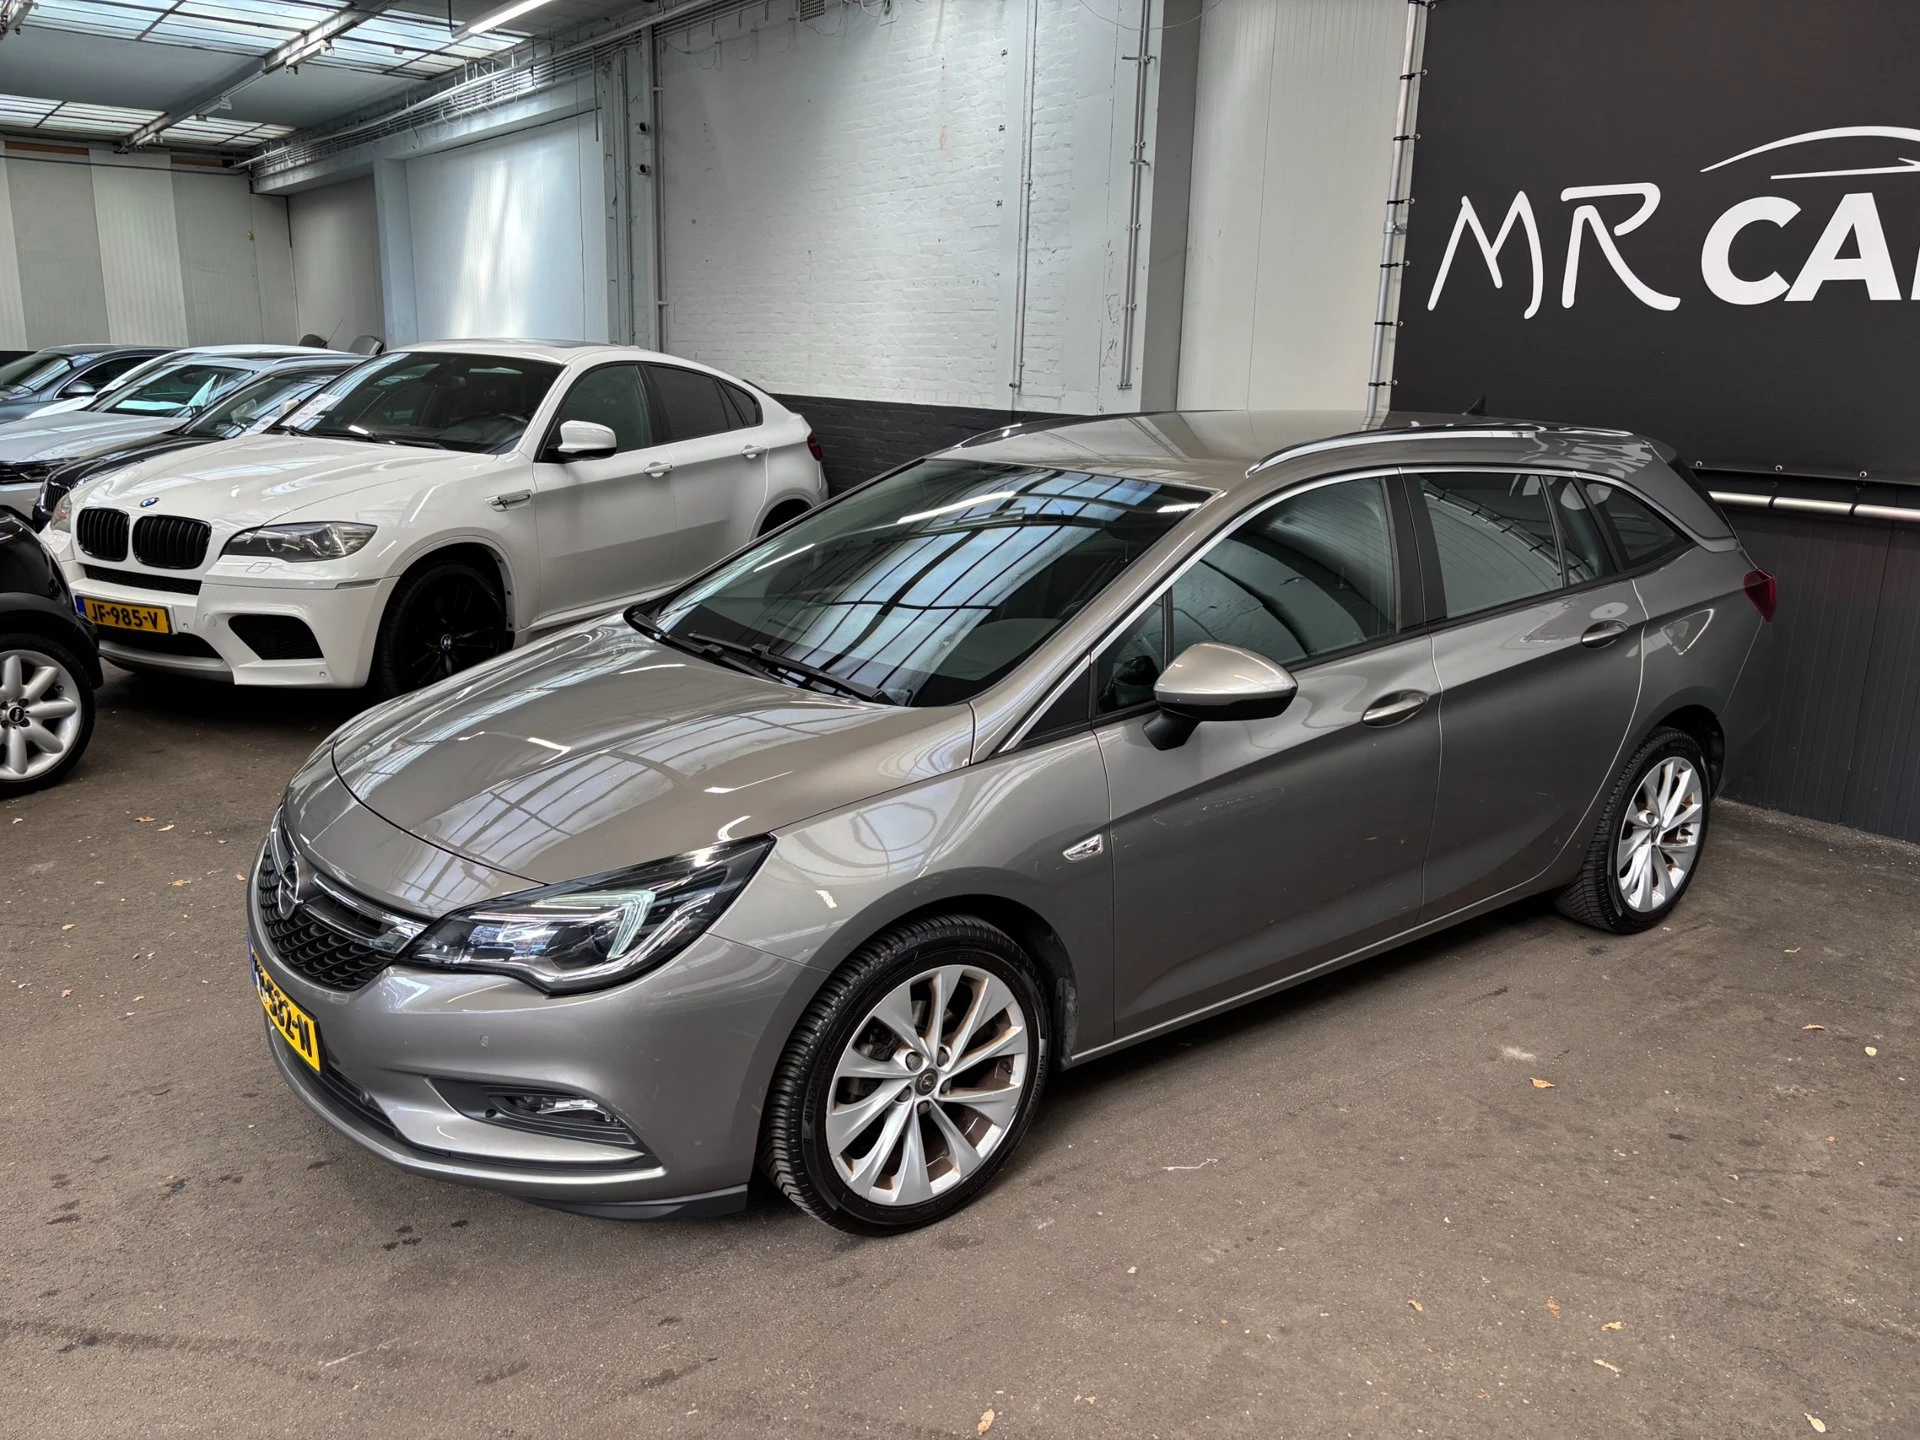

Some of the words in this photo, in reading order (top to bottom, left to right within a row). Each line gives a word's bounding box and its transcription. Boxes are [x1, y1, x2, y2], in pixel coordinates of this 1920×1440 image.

[1427, 182, 1681, 319] MR
[1701, 192, 1920, 306] CA
[92, 603, 158, 630] JF-985-V
